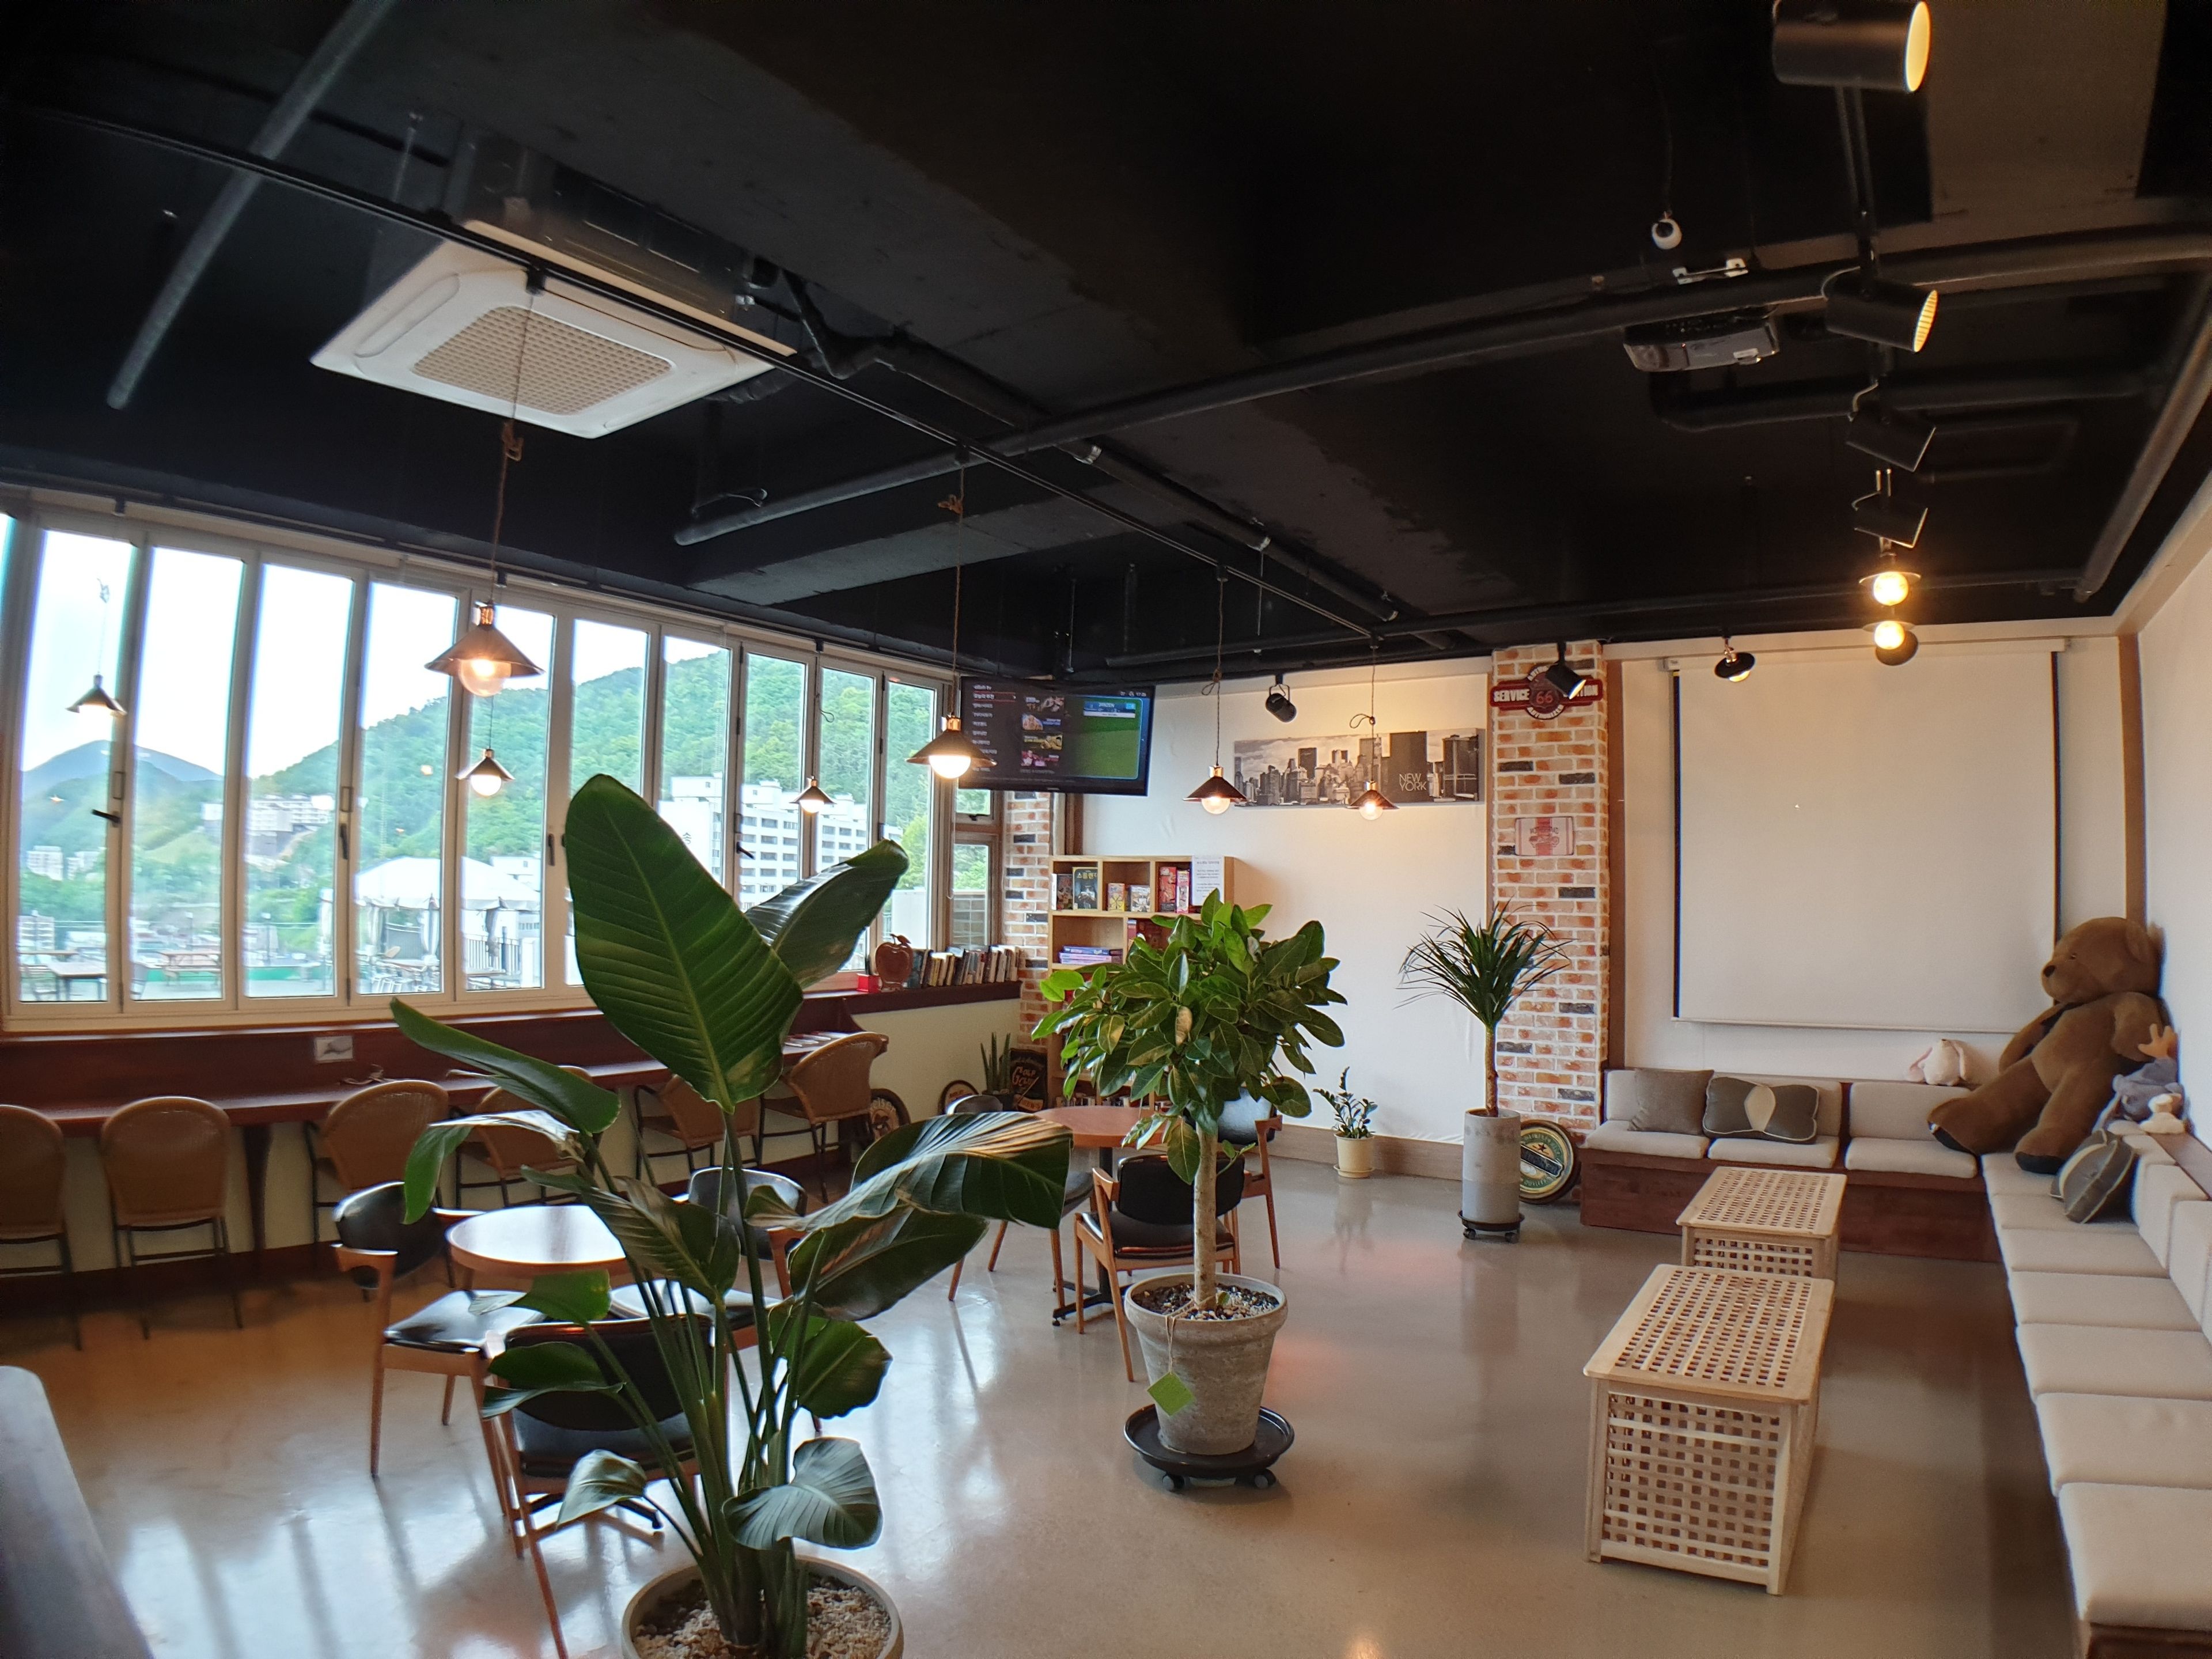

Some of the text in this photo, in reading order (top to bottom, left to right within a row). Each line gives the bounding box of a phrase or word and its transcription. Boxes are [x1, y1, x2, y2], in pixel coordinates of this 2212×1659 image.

[1494, 688, 1530, 702] SERVICE
[1536, 691, 1554, 704] 66
[1399, 773, 1422, 782] NEW
[1399, 781, 1427, 791] YORK
